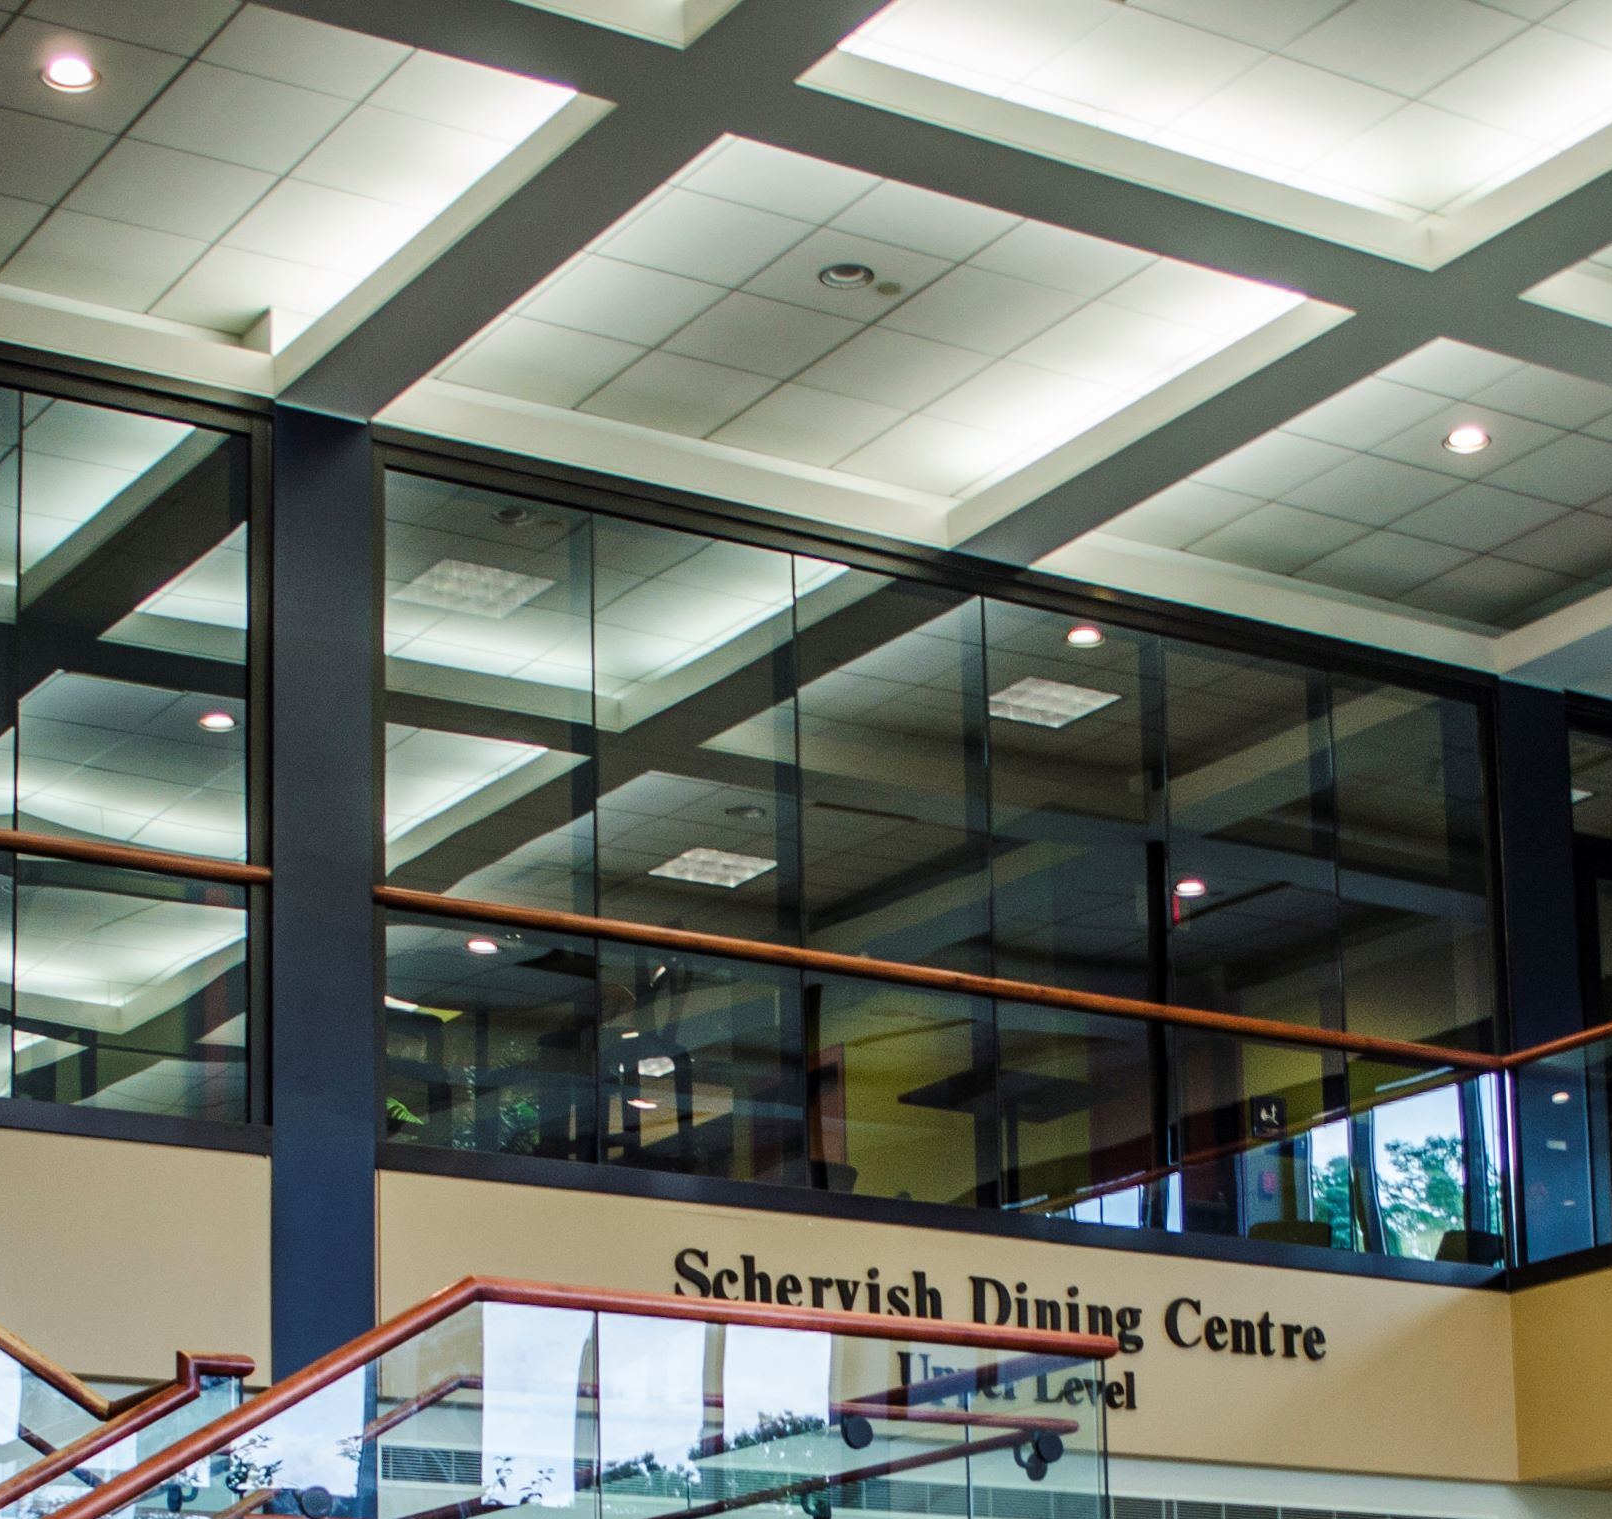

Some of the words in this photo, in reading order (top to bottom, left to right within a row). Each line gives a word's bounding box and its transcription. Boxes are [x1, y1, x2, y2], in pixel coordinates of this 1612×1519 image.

[674, 1247, 943, 1321] Schervish
[968, 1274, 1144, 1353] Dining
[1163, 1296, 1327, 1362] Centre
[1034, 1367, 1138, 1411] Level
